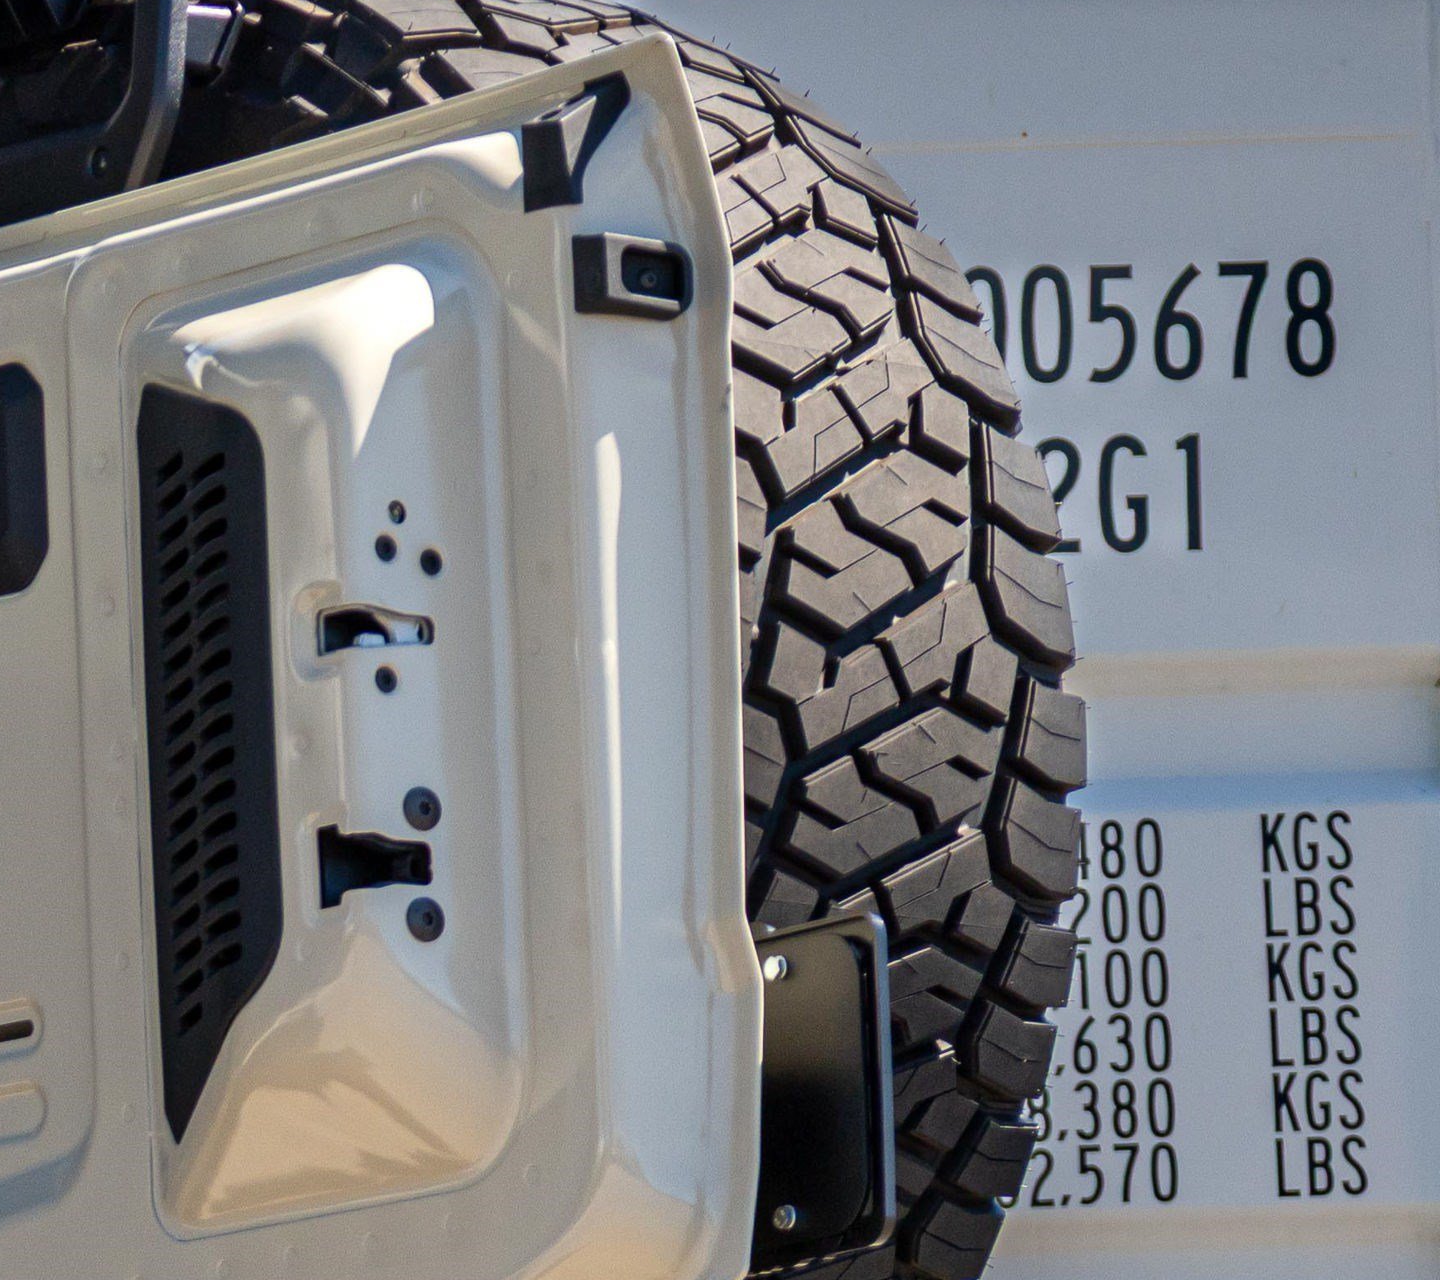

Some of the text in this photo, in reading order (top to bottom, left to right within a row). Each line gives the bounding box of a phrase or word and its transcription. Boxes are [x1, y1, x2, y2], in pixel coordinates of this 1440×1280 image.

[1260, 810, 1354, 872] KGS
[1263, 875, 1356, 937] LBS
[1266, 940, 1360, 1002] KGS
[1269, 1005, 1362, 1067] LBS
[1272, 1070, 1366, 1132] KGS
[995, 1135, 1369, 1208] 2,570 LBS
